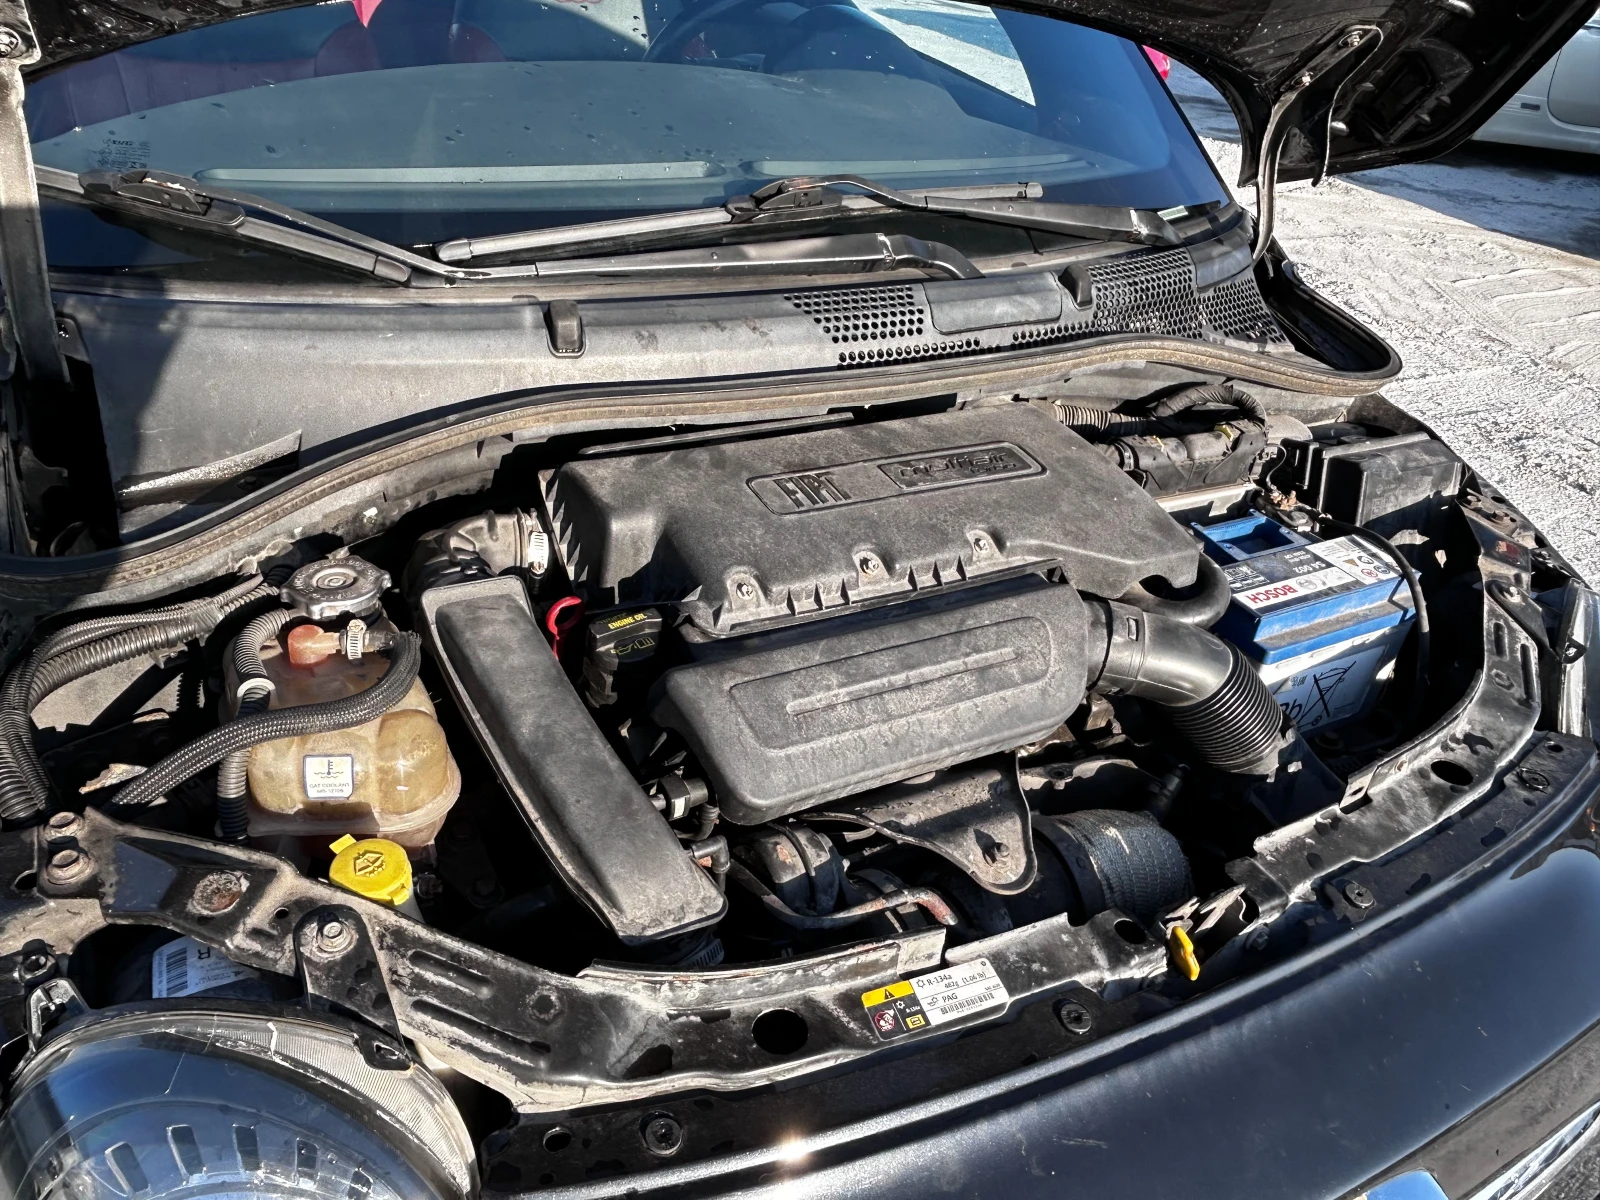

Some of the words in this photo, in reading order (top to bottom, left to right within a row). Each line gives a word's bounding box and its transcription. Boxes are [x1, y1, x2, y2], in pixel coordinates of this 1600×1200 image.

[772, 471, 852, 510] FIAT
[1245, 584, 1298, 604] BOSCH
[608, 616, 635, 629] ENGINE
[634, 613, 647, 621] OIL
[197, 947, 211, 960] R
[926, 974, 953, 987] R-134a
[977, 971, 987, 981] lb)
[941, 992, 958, 1003] PAG
